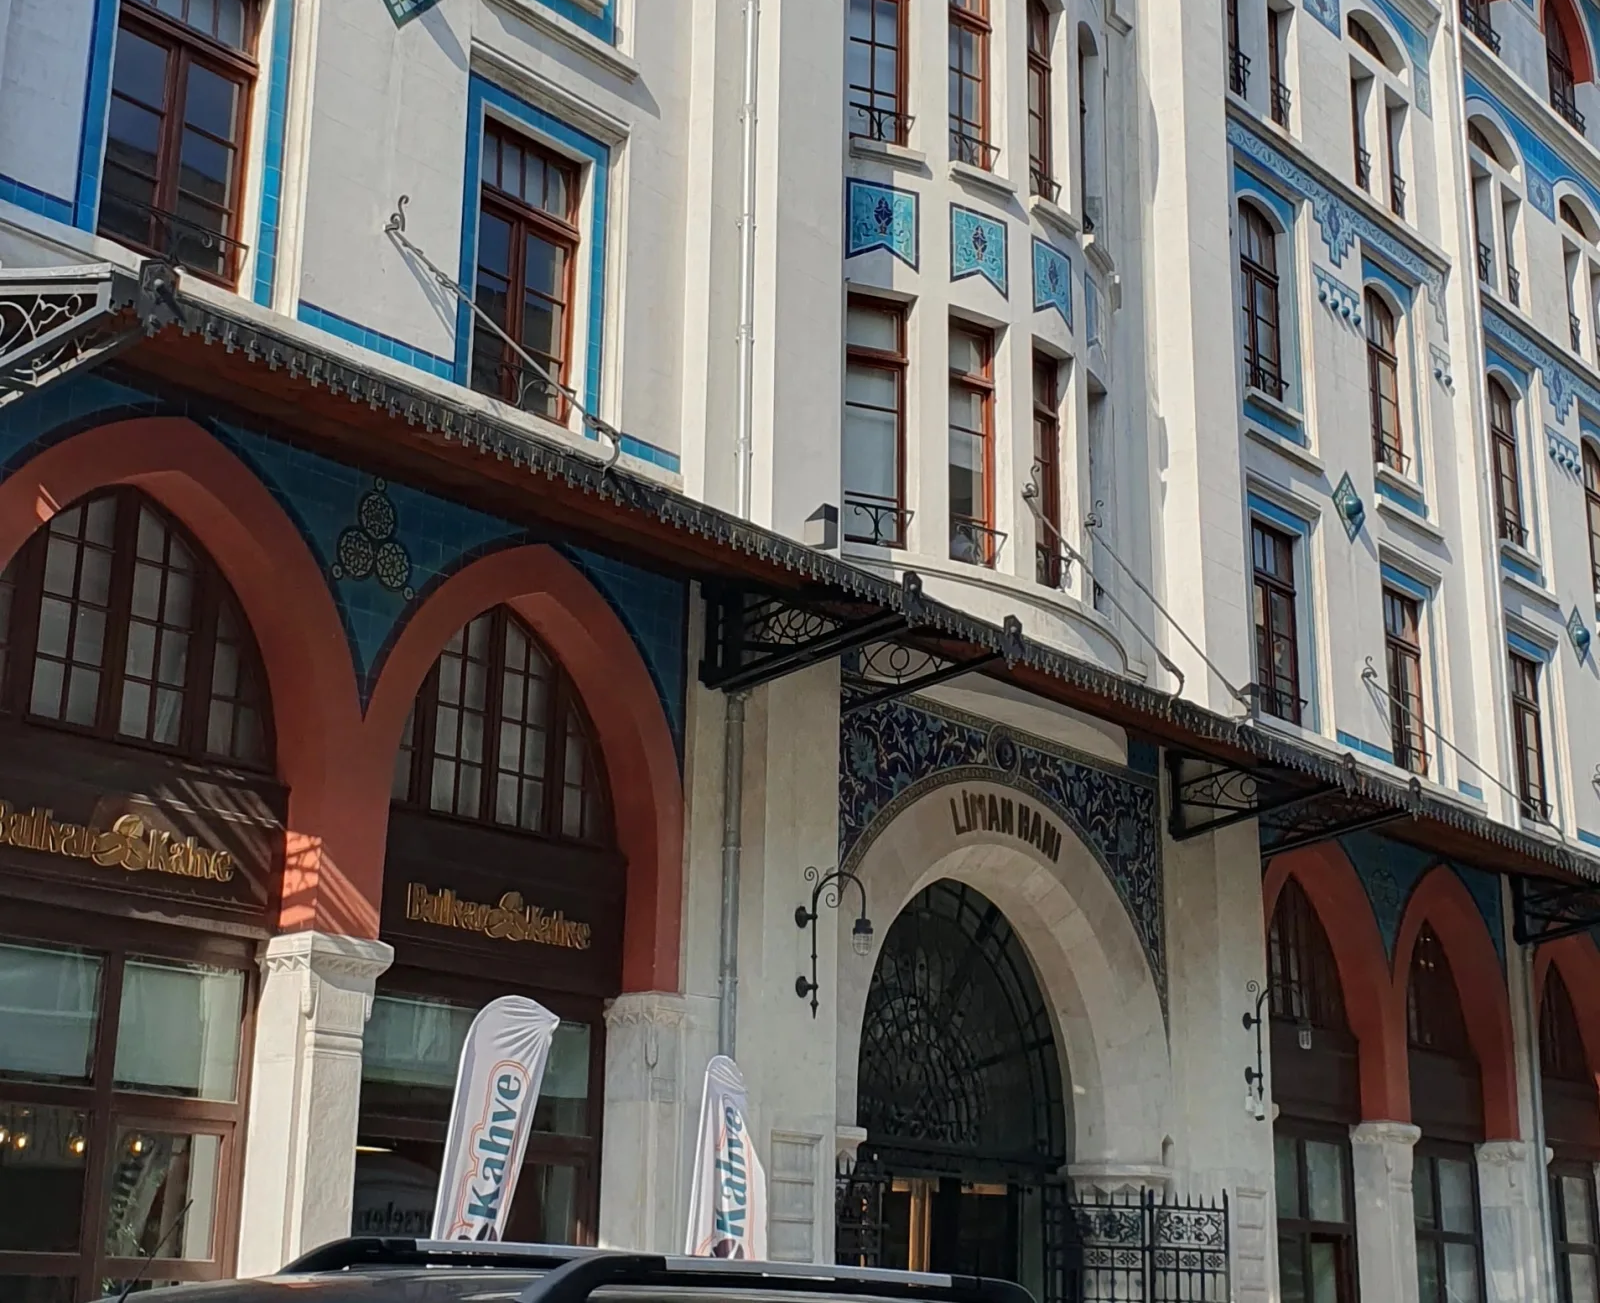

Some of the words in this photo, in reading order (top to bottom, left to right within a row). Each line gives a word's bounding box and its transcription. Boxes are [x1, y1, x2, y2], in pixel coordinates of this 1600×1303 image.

[147, 828, 234, 881] Kahve
[1017, 801, 1062, 864] HANI
[526, 905, 591, 949] Kahve
[468, 1074, 522, 1220] Kahve
[715, 1106, 746, 1237] Kahve
